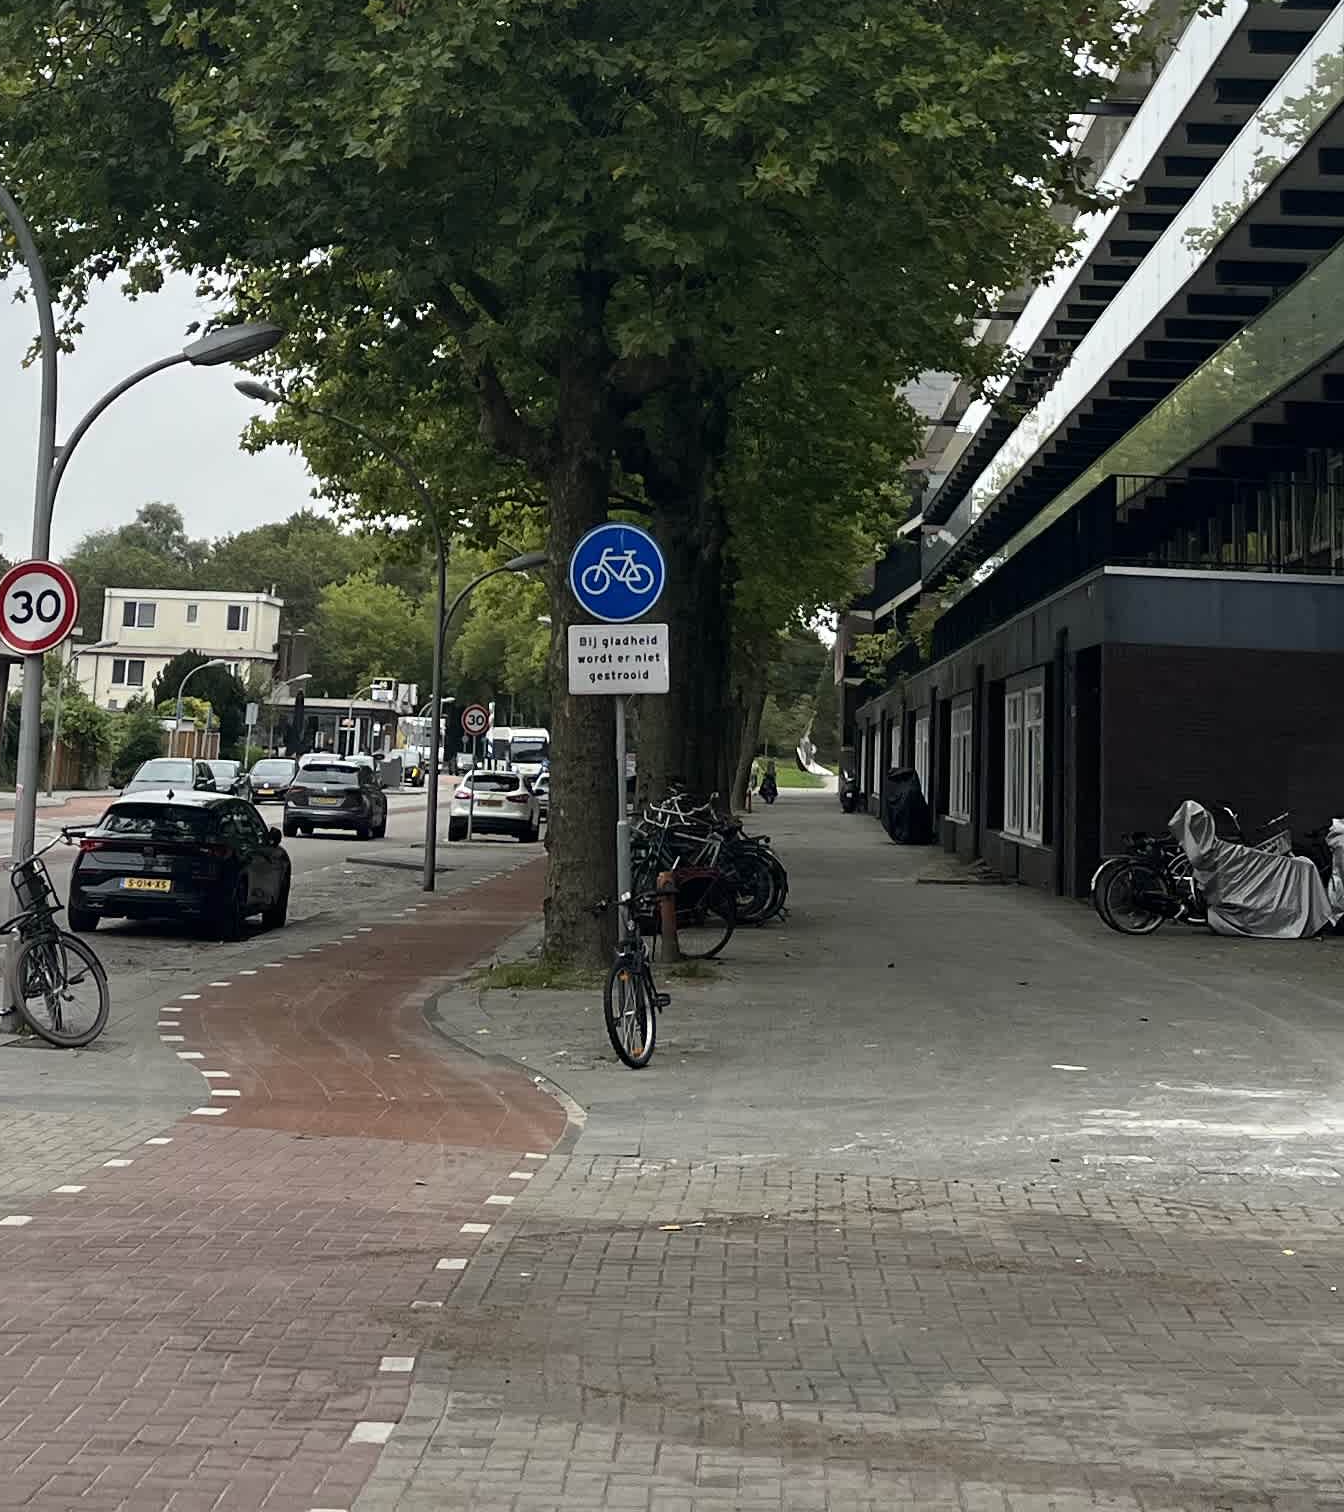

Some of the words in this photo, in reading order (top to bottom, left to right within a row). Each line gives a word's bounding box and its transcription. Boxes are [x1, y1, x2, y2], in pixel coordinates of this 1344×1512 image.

[9, 589, 61, 624] 30
[579, 636, 597, 649] Bij
[601, 635, 658, 649] gladheid
[577, 653, 613, 664] wordt
[617, 655, 630, 663] er
[635, 653, 660, 663] niet
[588, 670, 649, 684] gestrooid
[467, 714, 485, 726] 30
